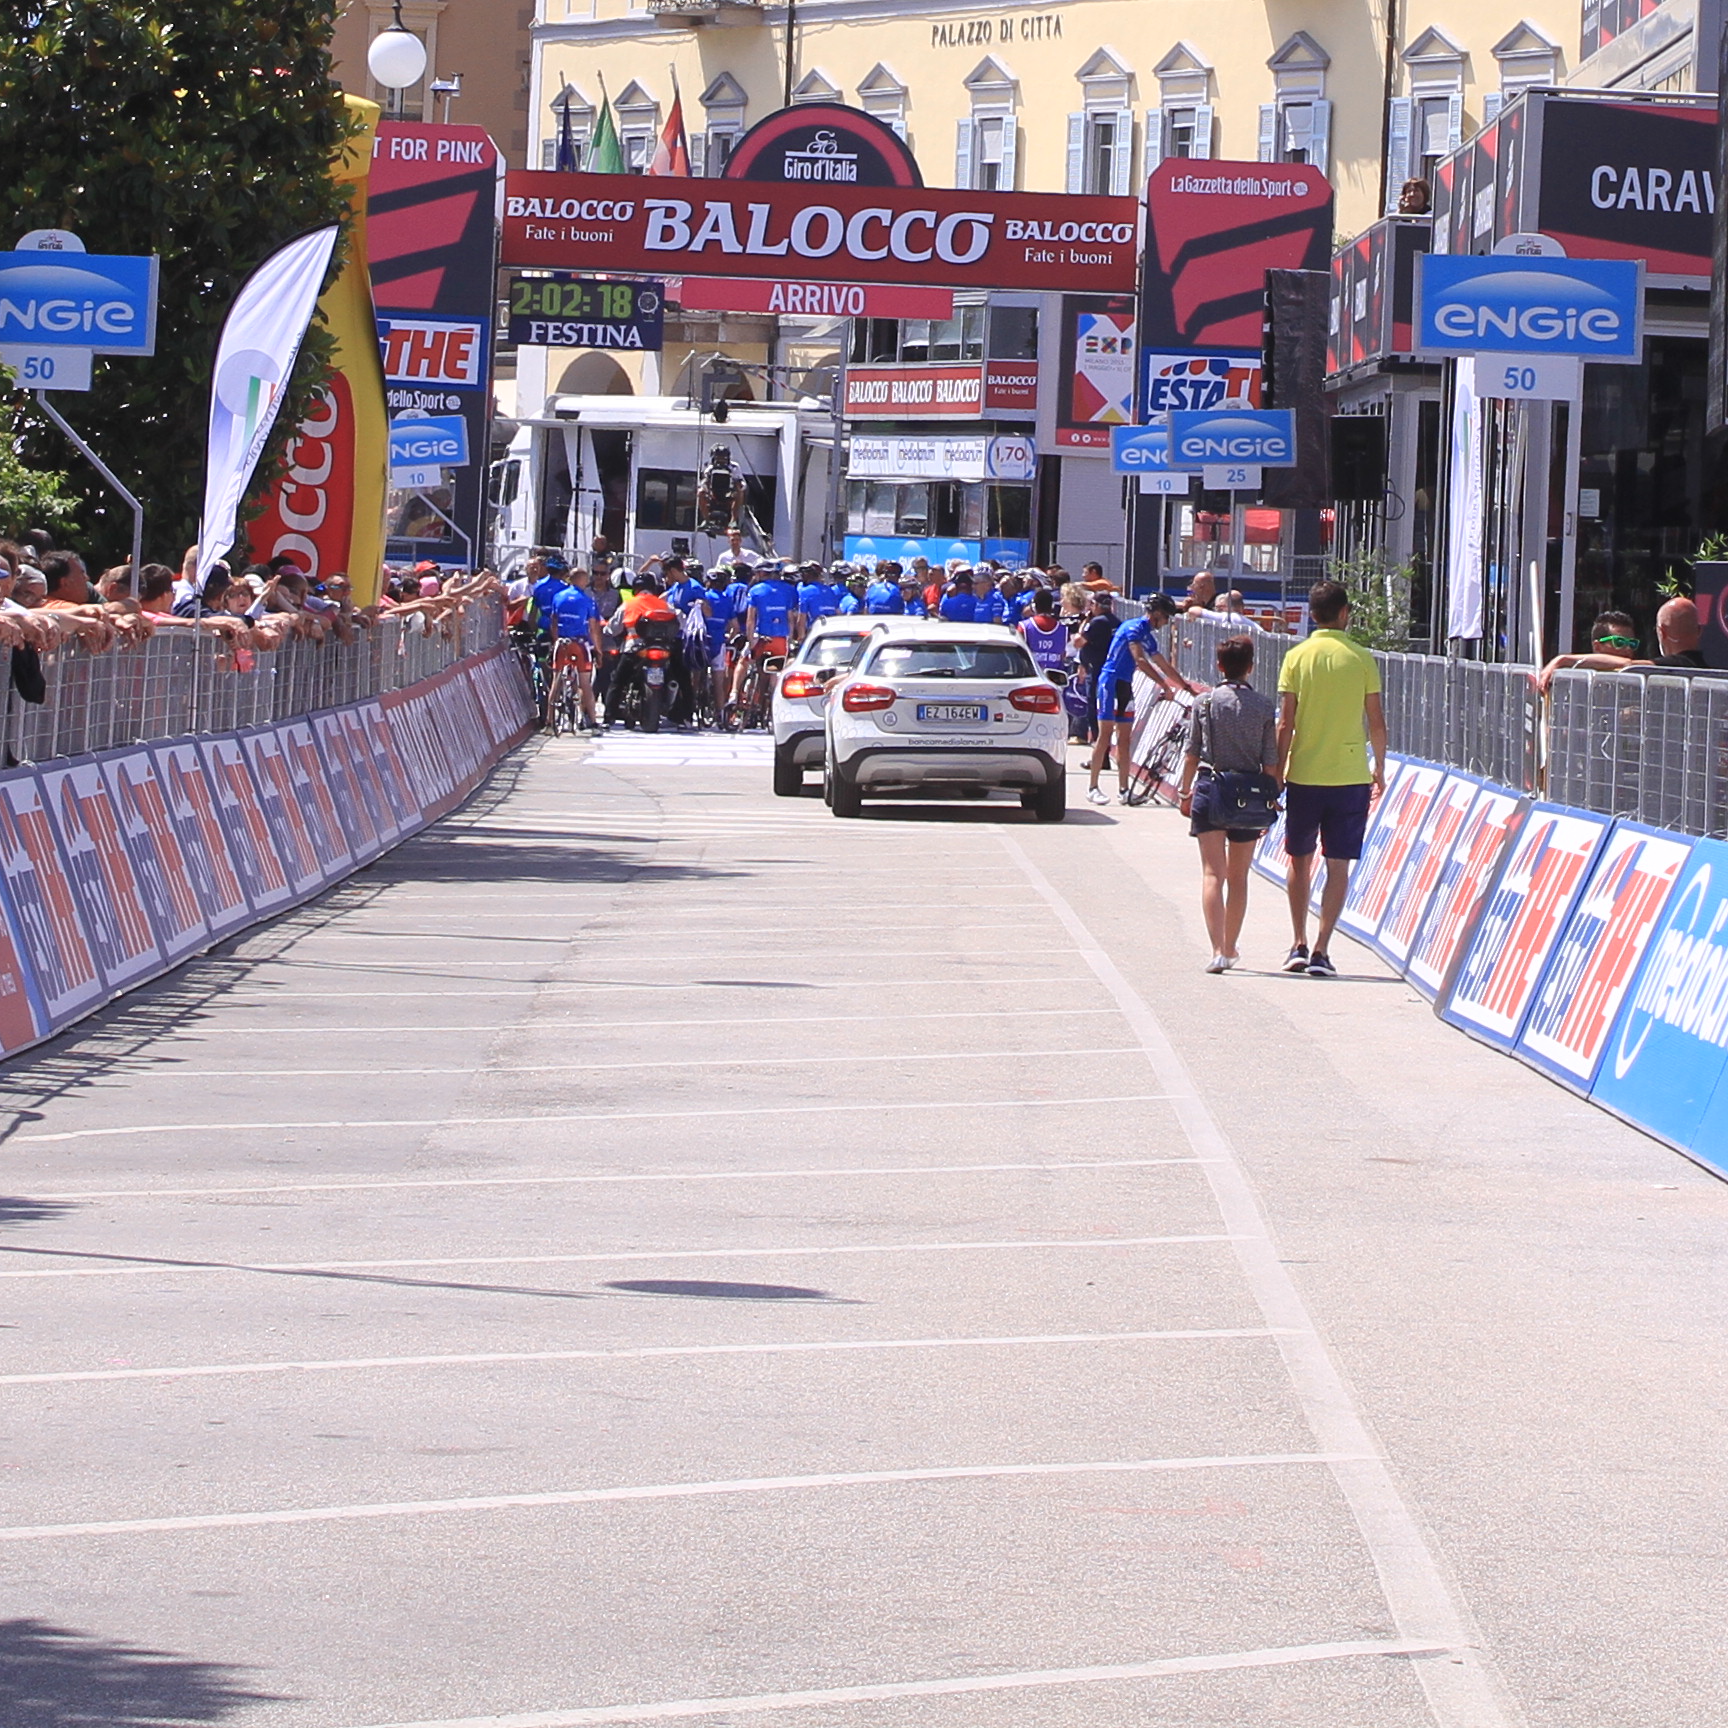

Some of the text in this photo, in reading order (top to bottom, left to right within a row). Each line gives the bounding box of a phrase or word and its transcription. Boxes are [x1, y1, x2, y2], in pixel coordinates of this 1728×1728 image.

[931, 20, 992, 47] PALAZZO
[1000, 18, 1013, 40] DI
[391, 138, 427, 161] FOR
[437, 140, 485, 164] PINK
[784, 158, 858, 182] Giro d'Italia
[1171, 175, 1292, 199] La Gazzetta dello Sport
[506, 196, 635, 221] BALOCCO
[525, 225, 614, 242] Fate i buoni
[642, 198, 996, 264] BALOCCO
[1005, 218, 1134, 245] BALOCCO
[1025, 247, 1113, 265] Fate i buoni
[768, 284, 865, 315] ARRIVO
[529, 321, 643, 348] FESTINA
[1086, 336, 1134, 356] EXP
[24, 356, 54, 381] 50
[988, 375, 1037, 386] BALOCCO
[1503, 366, 1537, 392] 50
[414, 391, 445, 410] Sport
[849, 379, 980, 404] BALOCCO BALOCCO BALOCCO
[271, 385, 338, 577] OCCO
[410, 473, 424, 484] 10
[1156, 480, 1171, 491] 10
[1227, 470, 1246, 483] 25
[1038, 640, 1053, 649] 109
[926, 706, 980, 719] EZ 164EW
[908, 737, 994, 746] bancamediolanum.it
